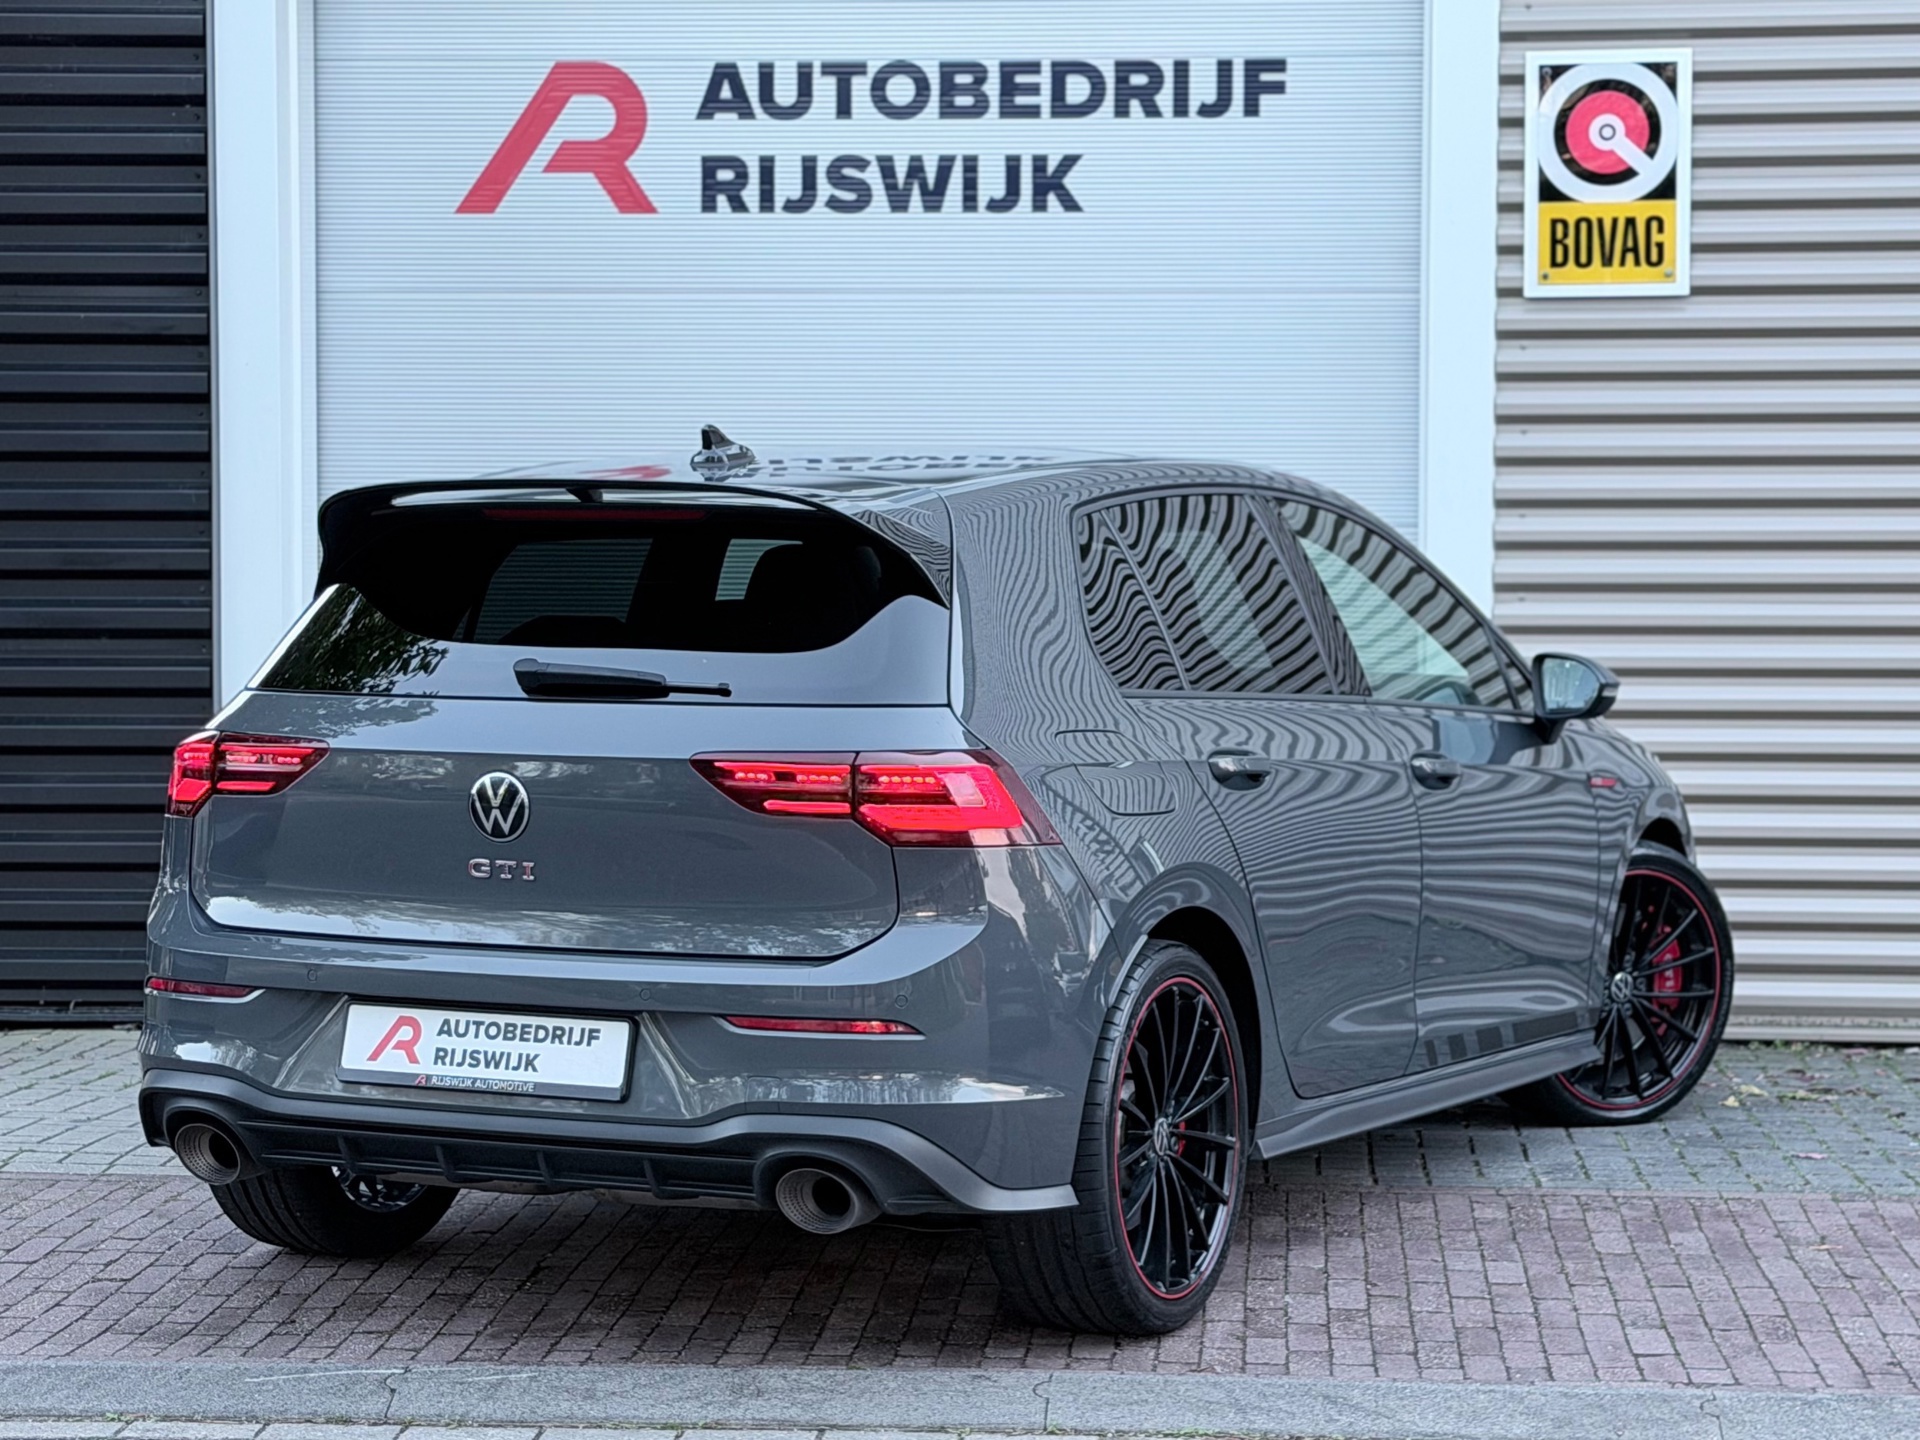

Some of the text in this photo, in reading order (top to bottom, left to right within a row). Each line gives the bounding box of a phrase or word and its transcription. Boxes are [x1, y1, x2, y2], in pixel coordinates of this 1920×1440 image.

[696, 58, 1286, 120] AUTOBEDRIJF
[700, 154, 1085, 214] RIJSWIJK
[1550, 215, 1664, 268] BOVAG
[468, 858, 535, 880] GTI
[436, 1018, 601, 1047] AUTOBEDRIJF
[433, 1047, 540, 1073] RIJSWIJK
[431, 1075, 535, 1092] RIJSWIJK AUTOMOTIVE
